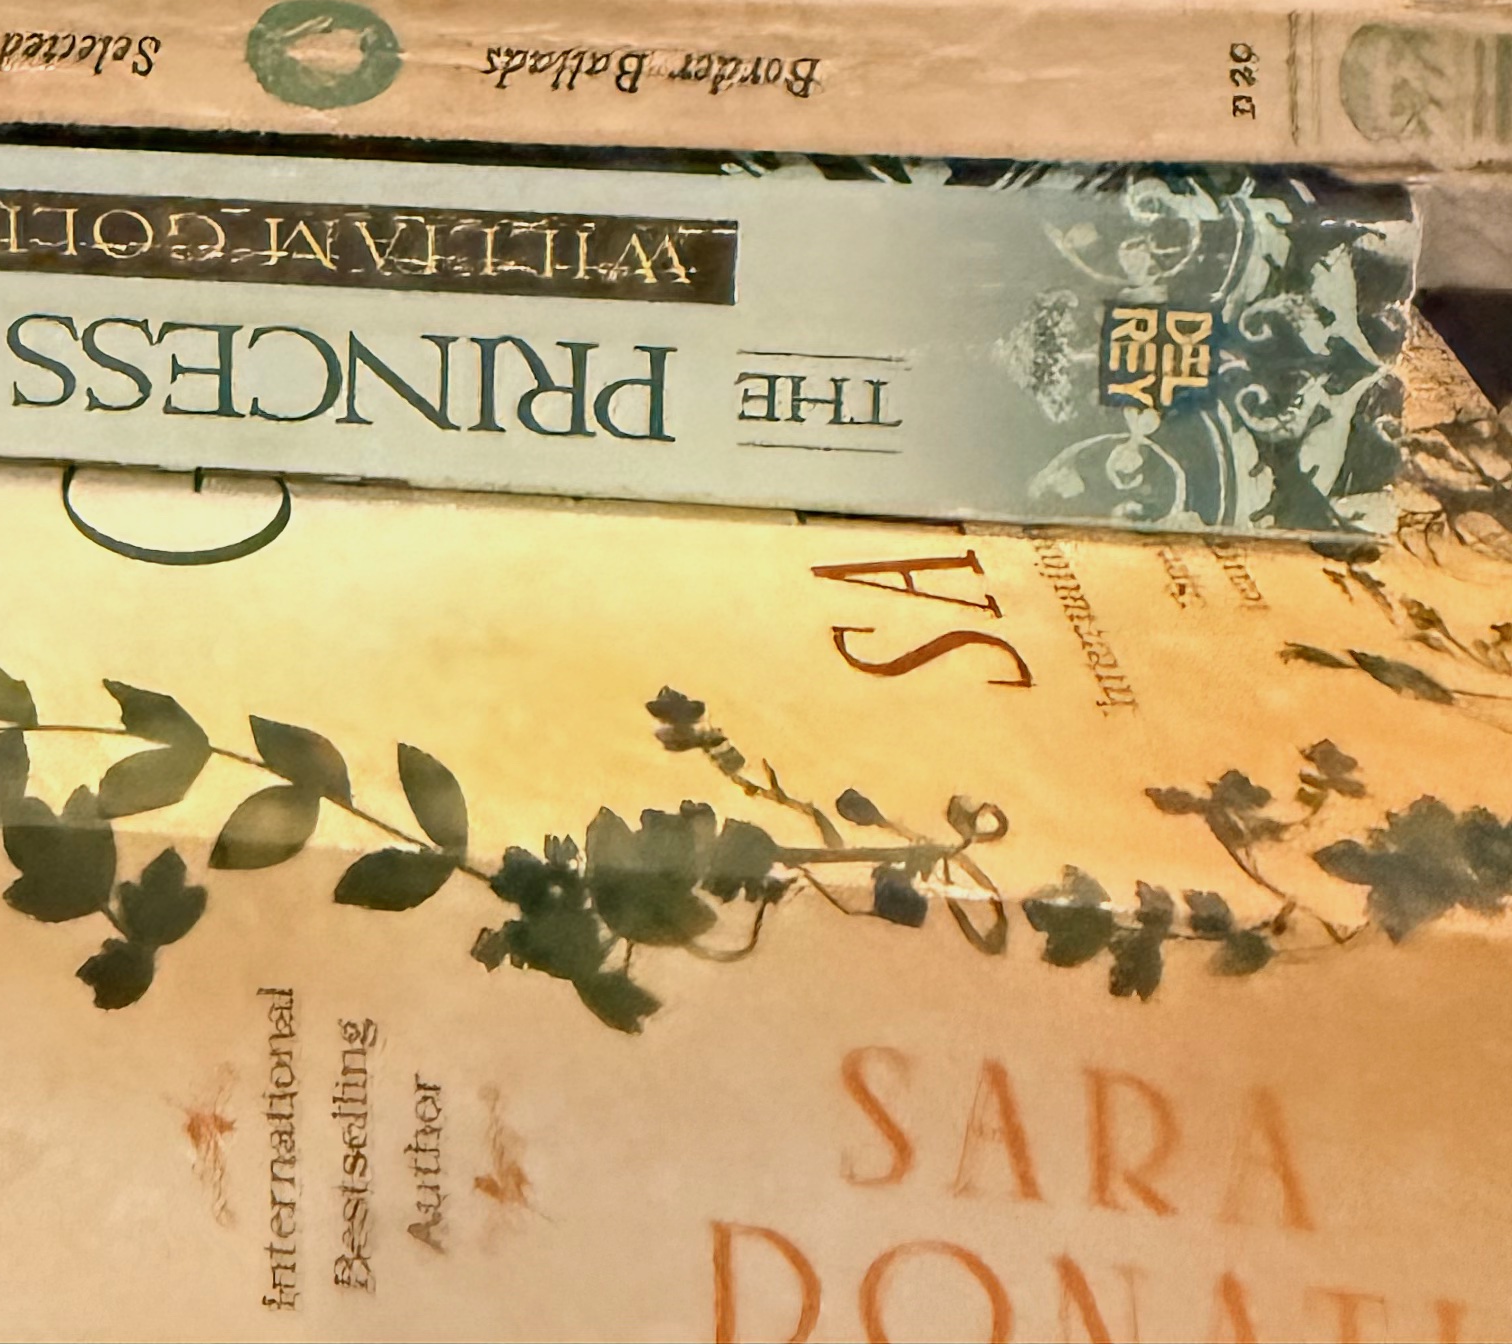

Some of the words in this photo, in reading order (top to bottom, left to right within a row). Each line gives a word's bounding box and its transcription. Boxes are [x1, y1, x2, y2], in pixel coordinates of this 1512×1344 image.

[481, 46, 650, 94] Ballads
[668, 52, 823, 99] Border
[259, 213, 694, 285] WILLIAM
[5, 312, 679, 443] PRINCESS
[734, 371, 904, 428] THE
[1107, 307, 1159, 408] REY
[1160, 310, 1214, 407] DEL
[403, 1070, 449, 1256] Author
[838, 1044, 1317, 1233] SARA
